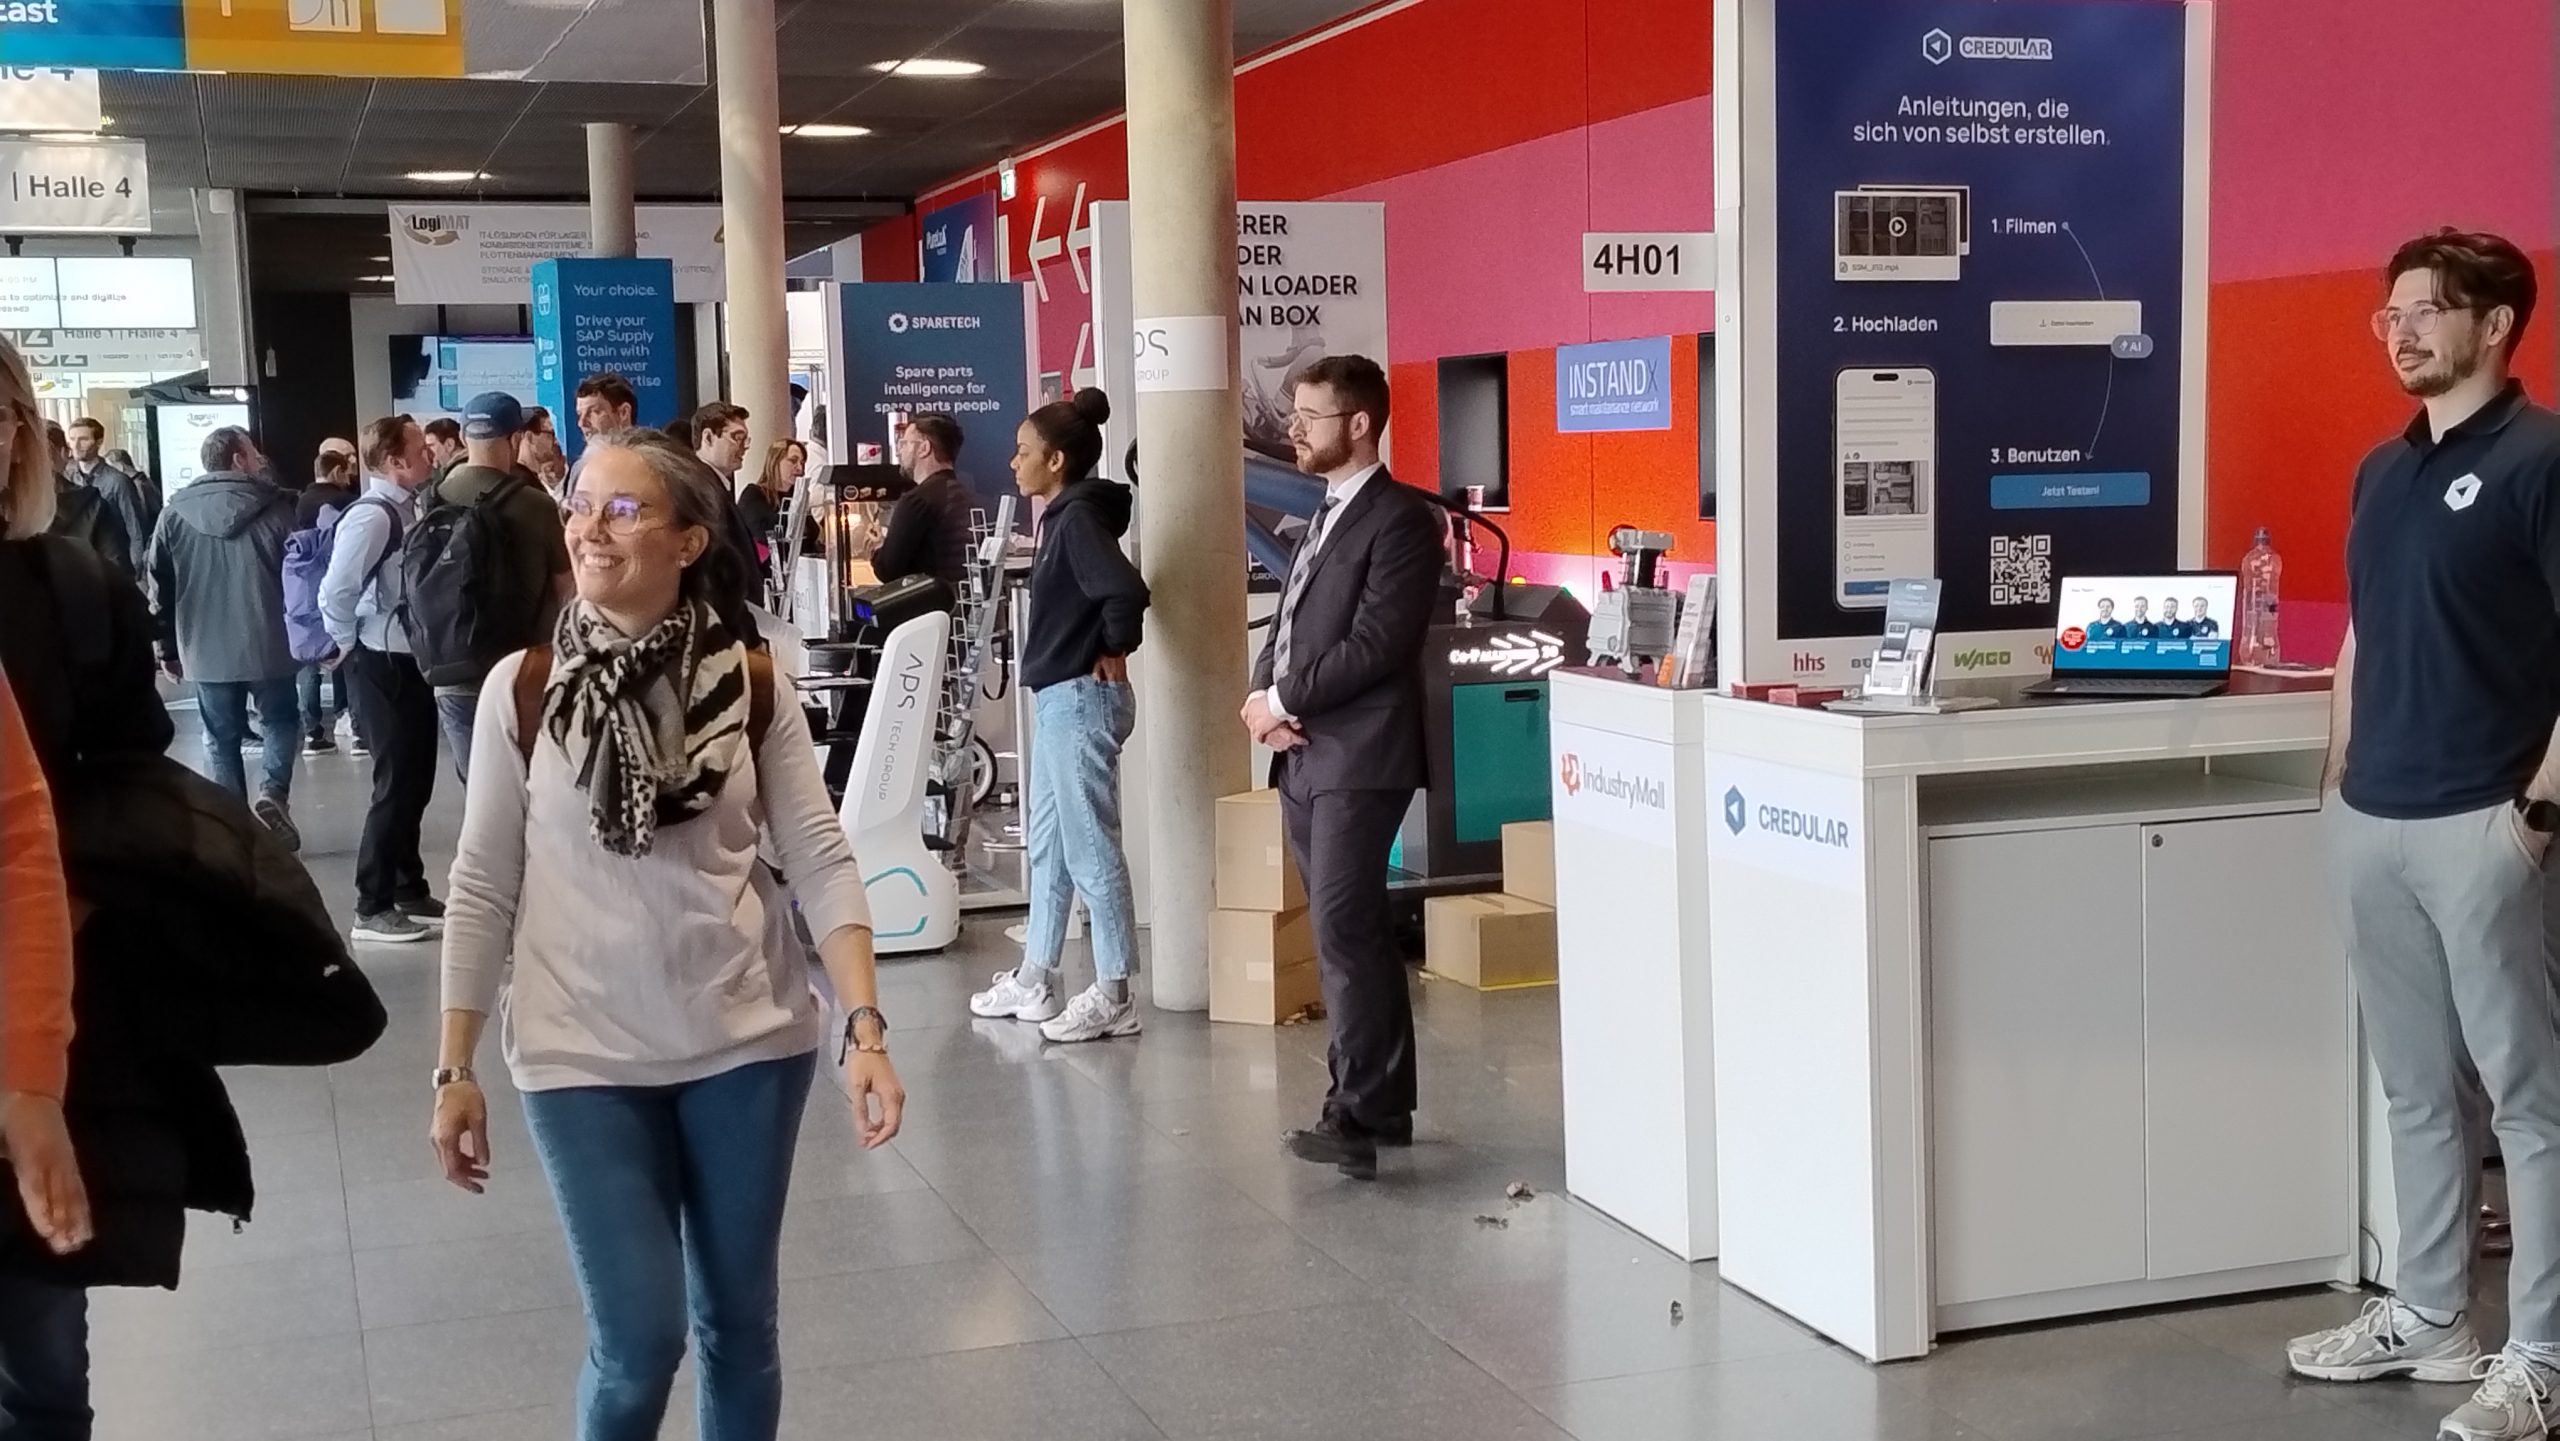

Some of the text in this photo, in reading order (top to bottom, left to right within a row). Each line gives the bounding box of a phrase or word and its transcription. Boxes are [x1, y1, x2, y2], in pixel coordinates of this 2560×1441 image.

[1960, 38, 2052, 59] CREDULAR
[1898, 95, 2070, 122] Anleitungen, die
[1853, 121, 2111, 145] sich von selbst erstellen.
[30, 175, 105, 198] Halle
[115, 176, 132, 198] 4
[411, 214, 471, 232] LogiMAT
[2006, 218, 2057, 234] Filmen
[1593, 243, 1679, 275] 4H01
[574, 284, 658, 297] Your choice.
[1262, 275, 1358, 296] LOADER
[575, 315, 646, 329] Drive your
[912, 316, 980, 329] SPARETECH
[1270, 305, 1321, 326] BOX
[1852, 315, 1938, 332] Hochladen
[576, 329, 654, 343] SAP Supply
[577, 345, 650, 357] Chain with
[578, 360, 648, 374] the power
[895, 366, 974, 380] Spare parts
[1568, 358, 1658, 399] INSTANDX
[884, 381, 986, 397] intelligence for
[874, 399, 1000, 416] spare parts people
[2008, 447, 2080, 464] Benutzen
[2042, 486, 2065, 497] Jetzt
[1794, 652, 1826, 672] hhs
[1954, 648, 2012, 671] WAGO
[1583, 762, 1665, 809] IndustryMall
[1759, 804, 1849, 848] CREDULAR
